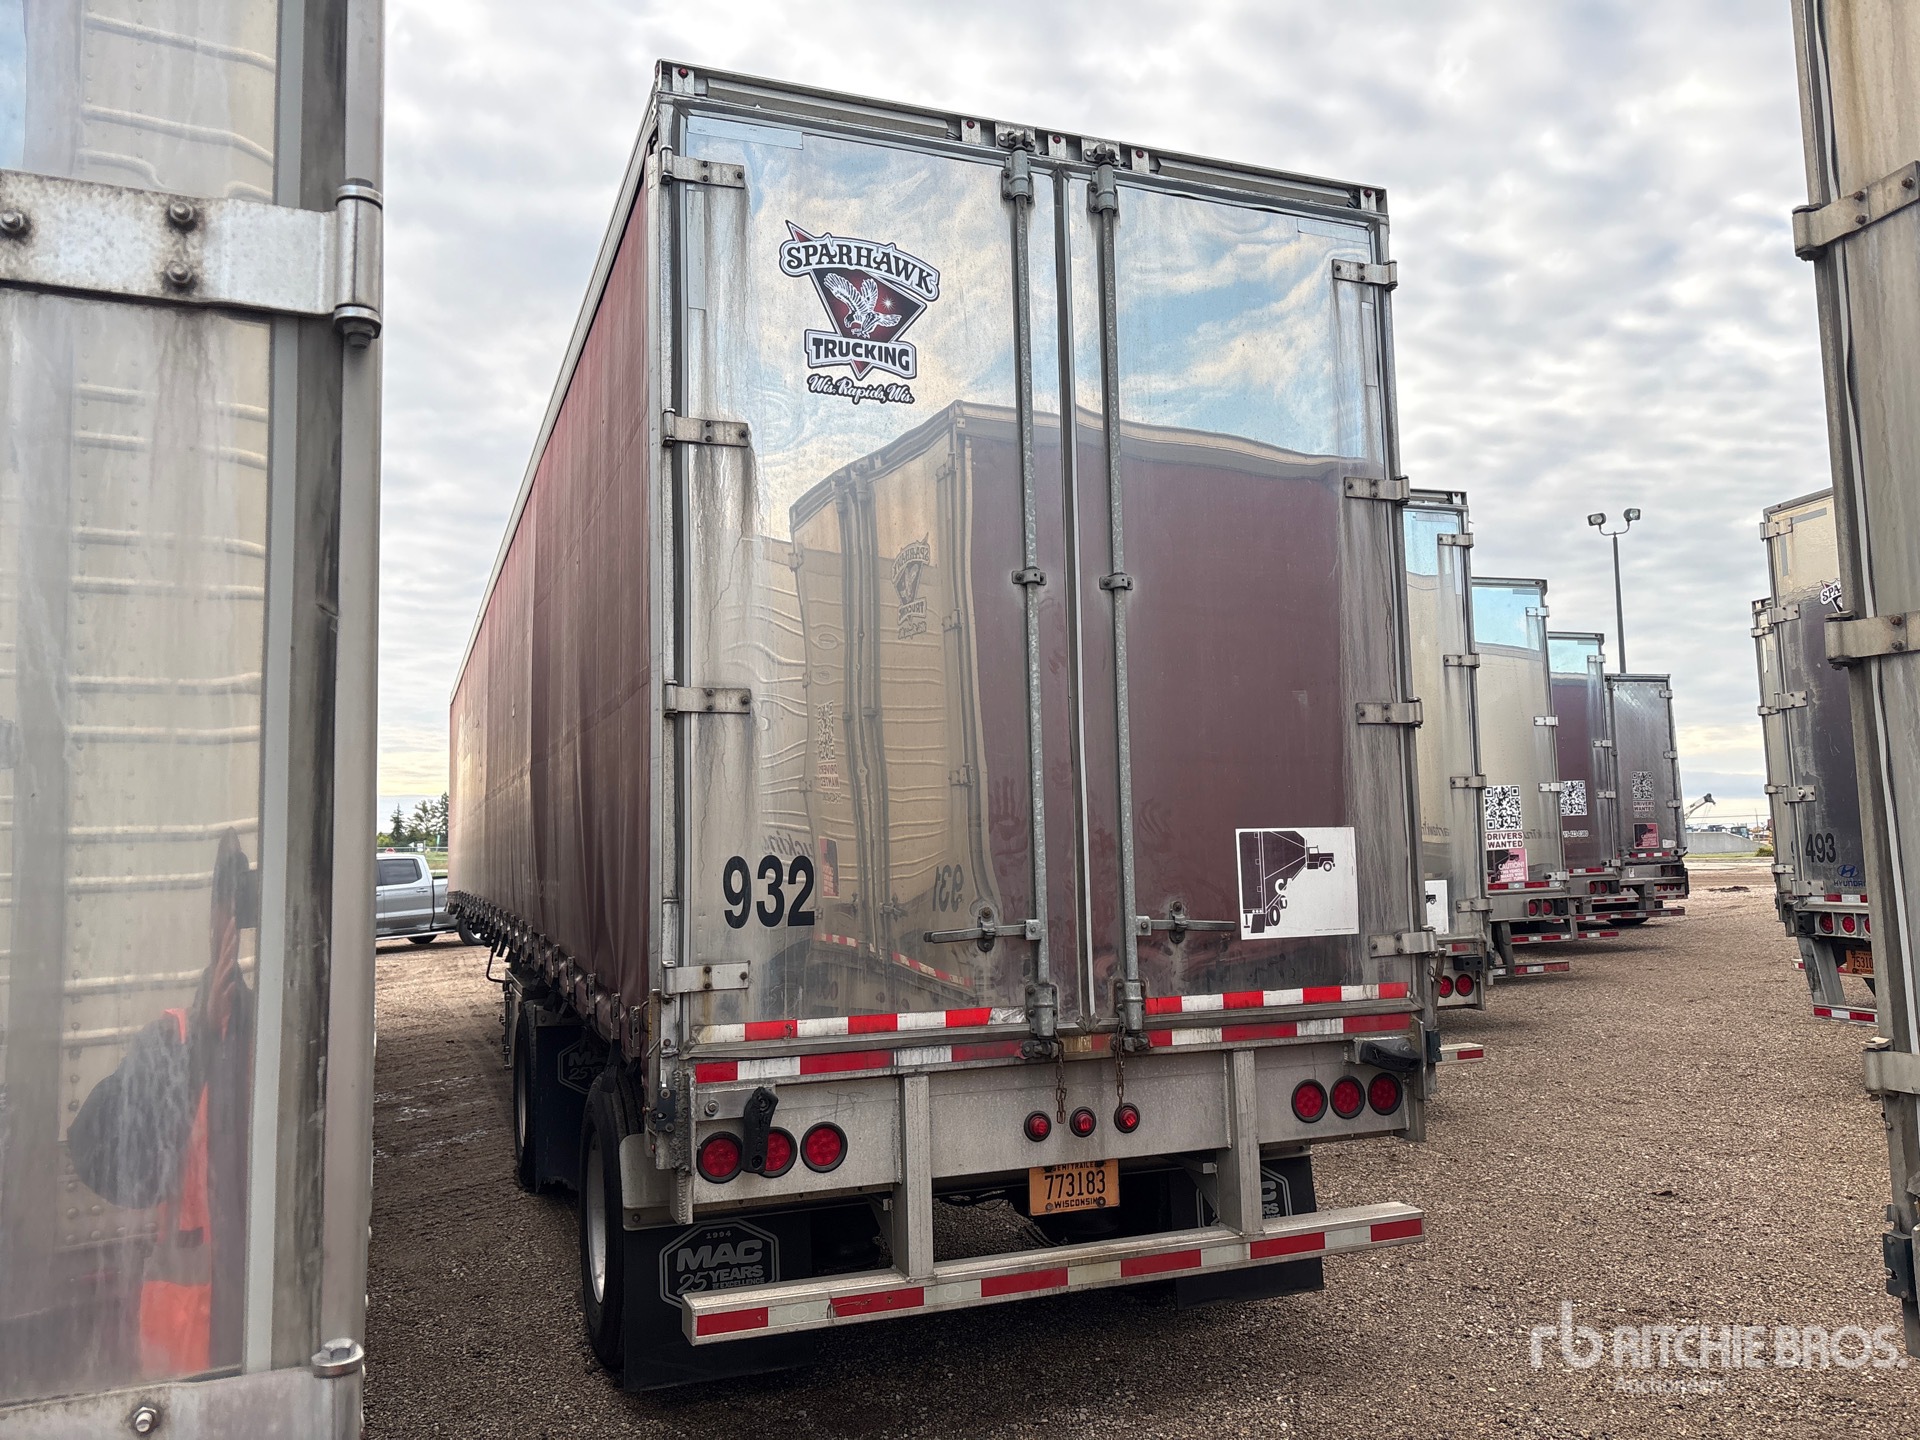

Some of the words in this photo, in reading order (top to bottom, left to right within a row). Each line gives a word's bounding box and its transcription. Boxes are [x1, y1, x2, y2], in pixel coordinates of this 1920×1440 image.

[786, 243, 933, 294] SPARHAWK
[812, 337, 909, 372] TRUCKING
[1486, 832, 1523, 841] DRIVERS
[1487, 840, 1523, 849] WANTED
[1805, 832, 1837, 863] 493
[722, 854, 815, 929] 932
[1852, 956, 1873, 969] 75310
[1044, 1170, 1106, 1200] 773183
[705, 1230, 732, 1239] 1994
[676, 1240, 763, 1272] MAC
[676, 1271, 709, 1295] 25
[709, 1265, 764, 1282] YEARS
[720, 1277, 765, 1289] EXCELLENCE
